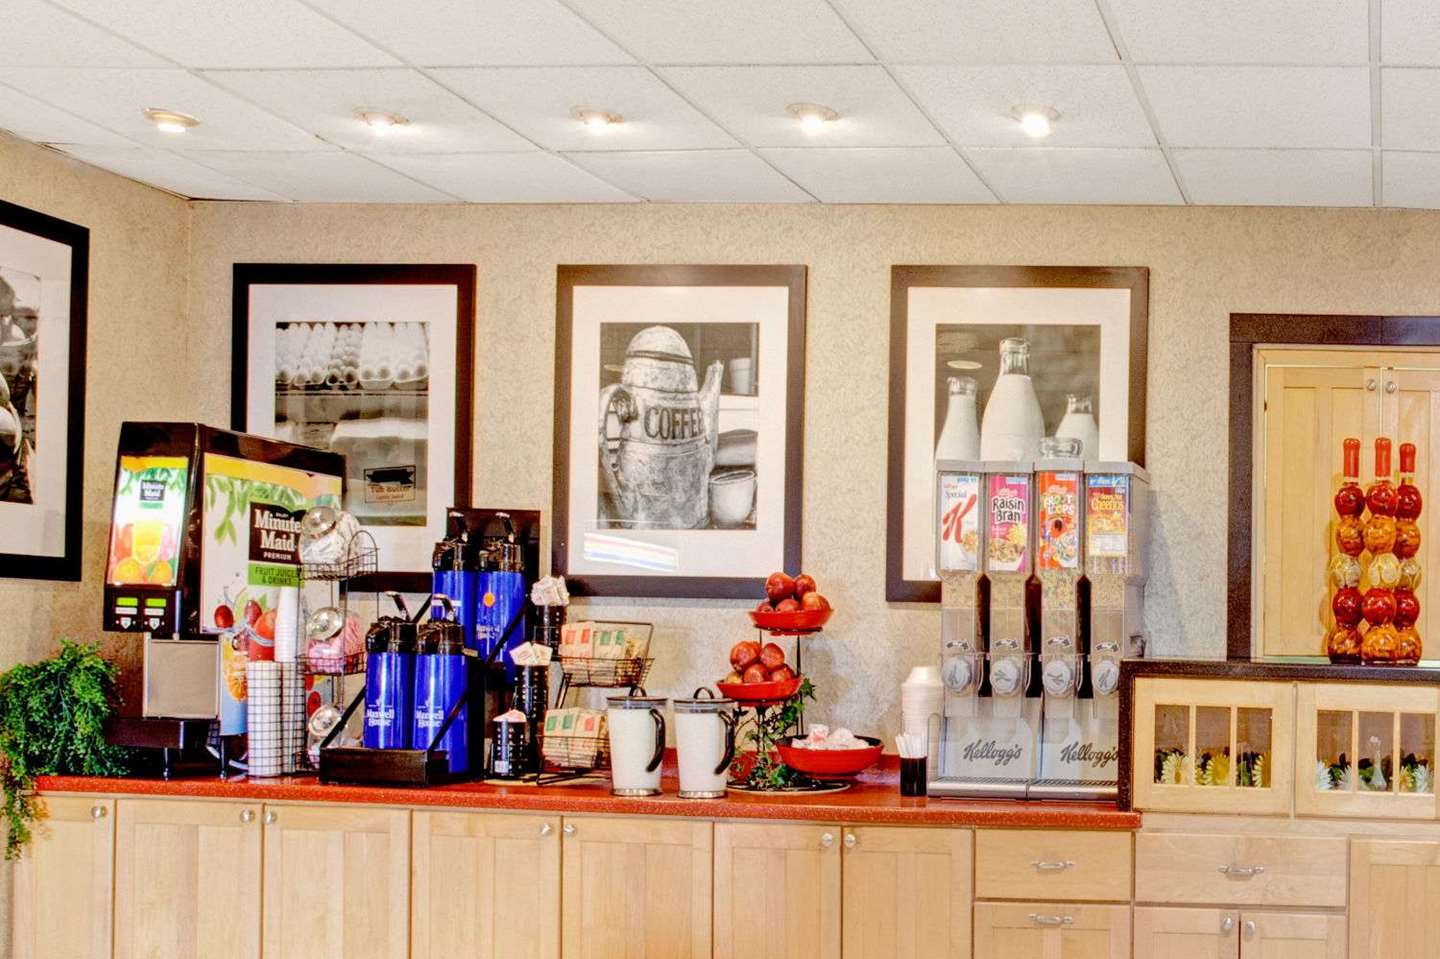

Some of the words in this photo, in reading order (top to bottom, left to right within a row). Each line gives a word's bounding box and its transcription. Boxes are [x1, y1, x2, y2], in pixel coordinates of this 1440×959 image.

[992, 496, 1025, 513] Raisin
[997, 509, 1021, 523] Bran
[254, 508, 301, 533] Minute
[260, 529, 296, 552] Maid
[263, 551, 292, 560] PREMIUM
[963, 738, 1023, 766] Kellogg's
[1060, 741, 1118, 768] Kellogg's
